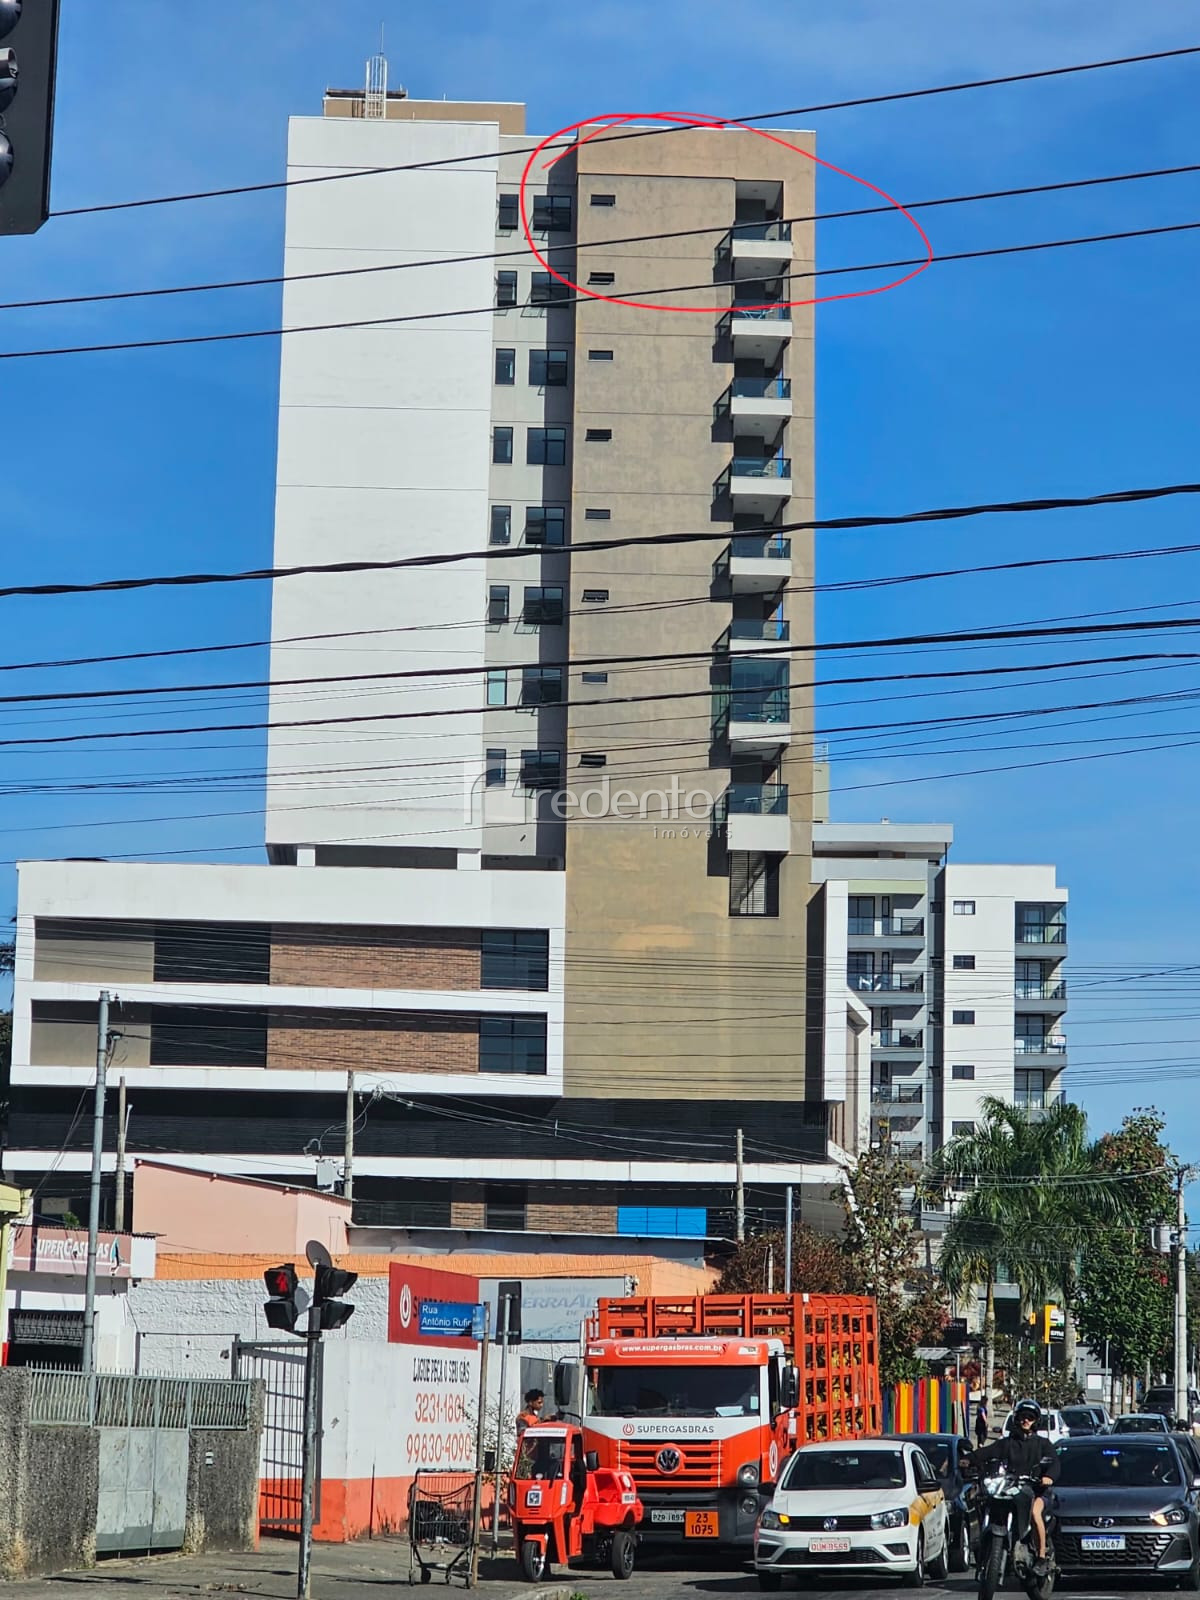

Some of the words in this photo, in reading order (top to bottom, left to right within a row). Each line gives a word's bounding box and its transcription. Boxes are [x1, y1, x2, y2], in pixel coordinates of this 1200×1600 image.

[422, 1304, 438, 1314] Rua
[421, 1317, 451, 1327] Antônio
[622, 1343, 722, 1352] www.supergasbras.com.br
[449, 1360, 459, 1383] SEU
[637, 1425, 714, 1434] SUPERGASBRAS
[696, 1513, 708, 1523] 23
[691, 1525, 713, 1535] 1075
